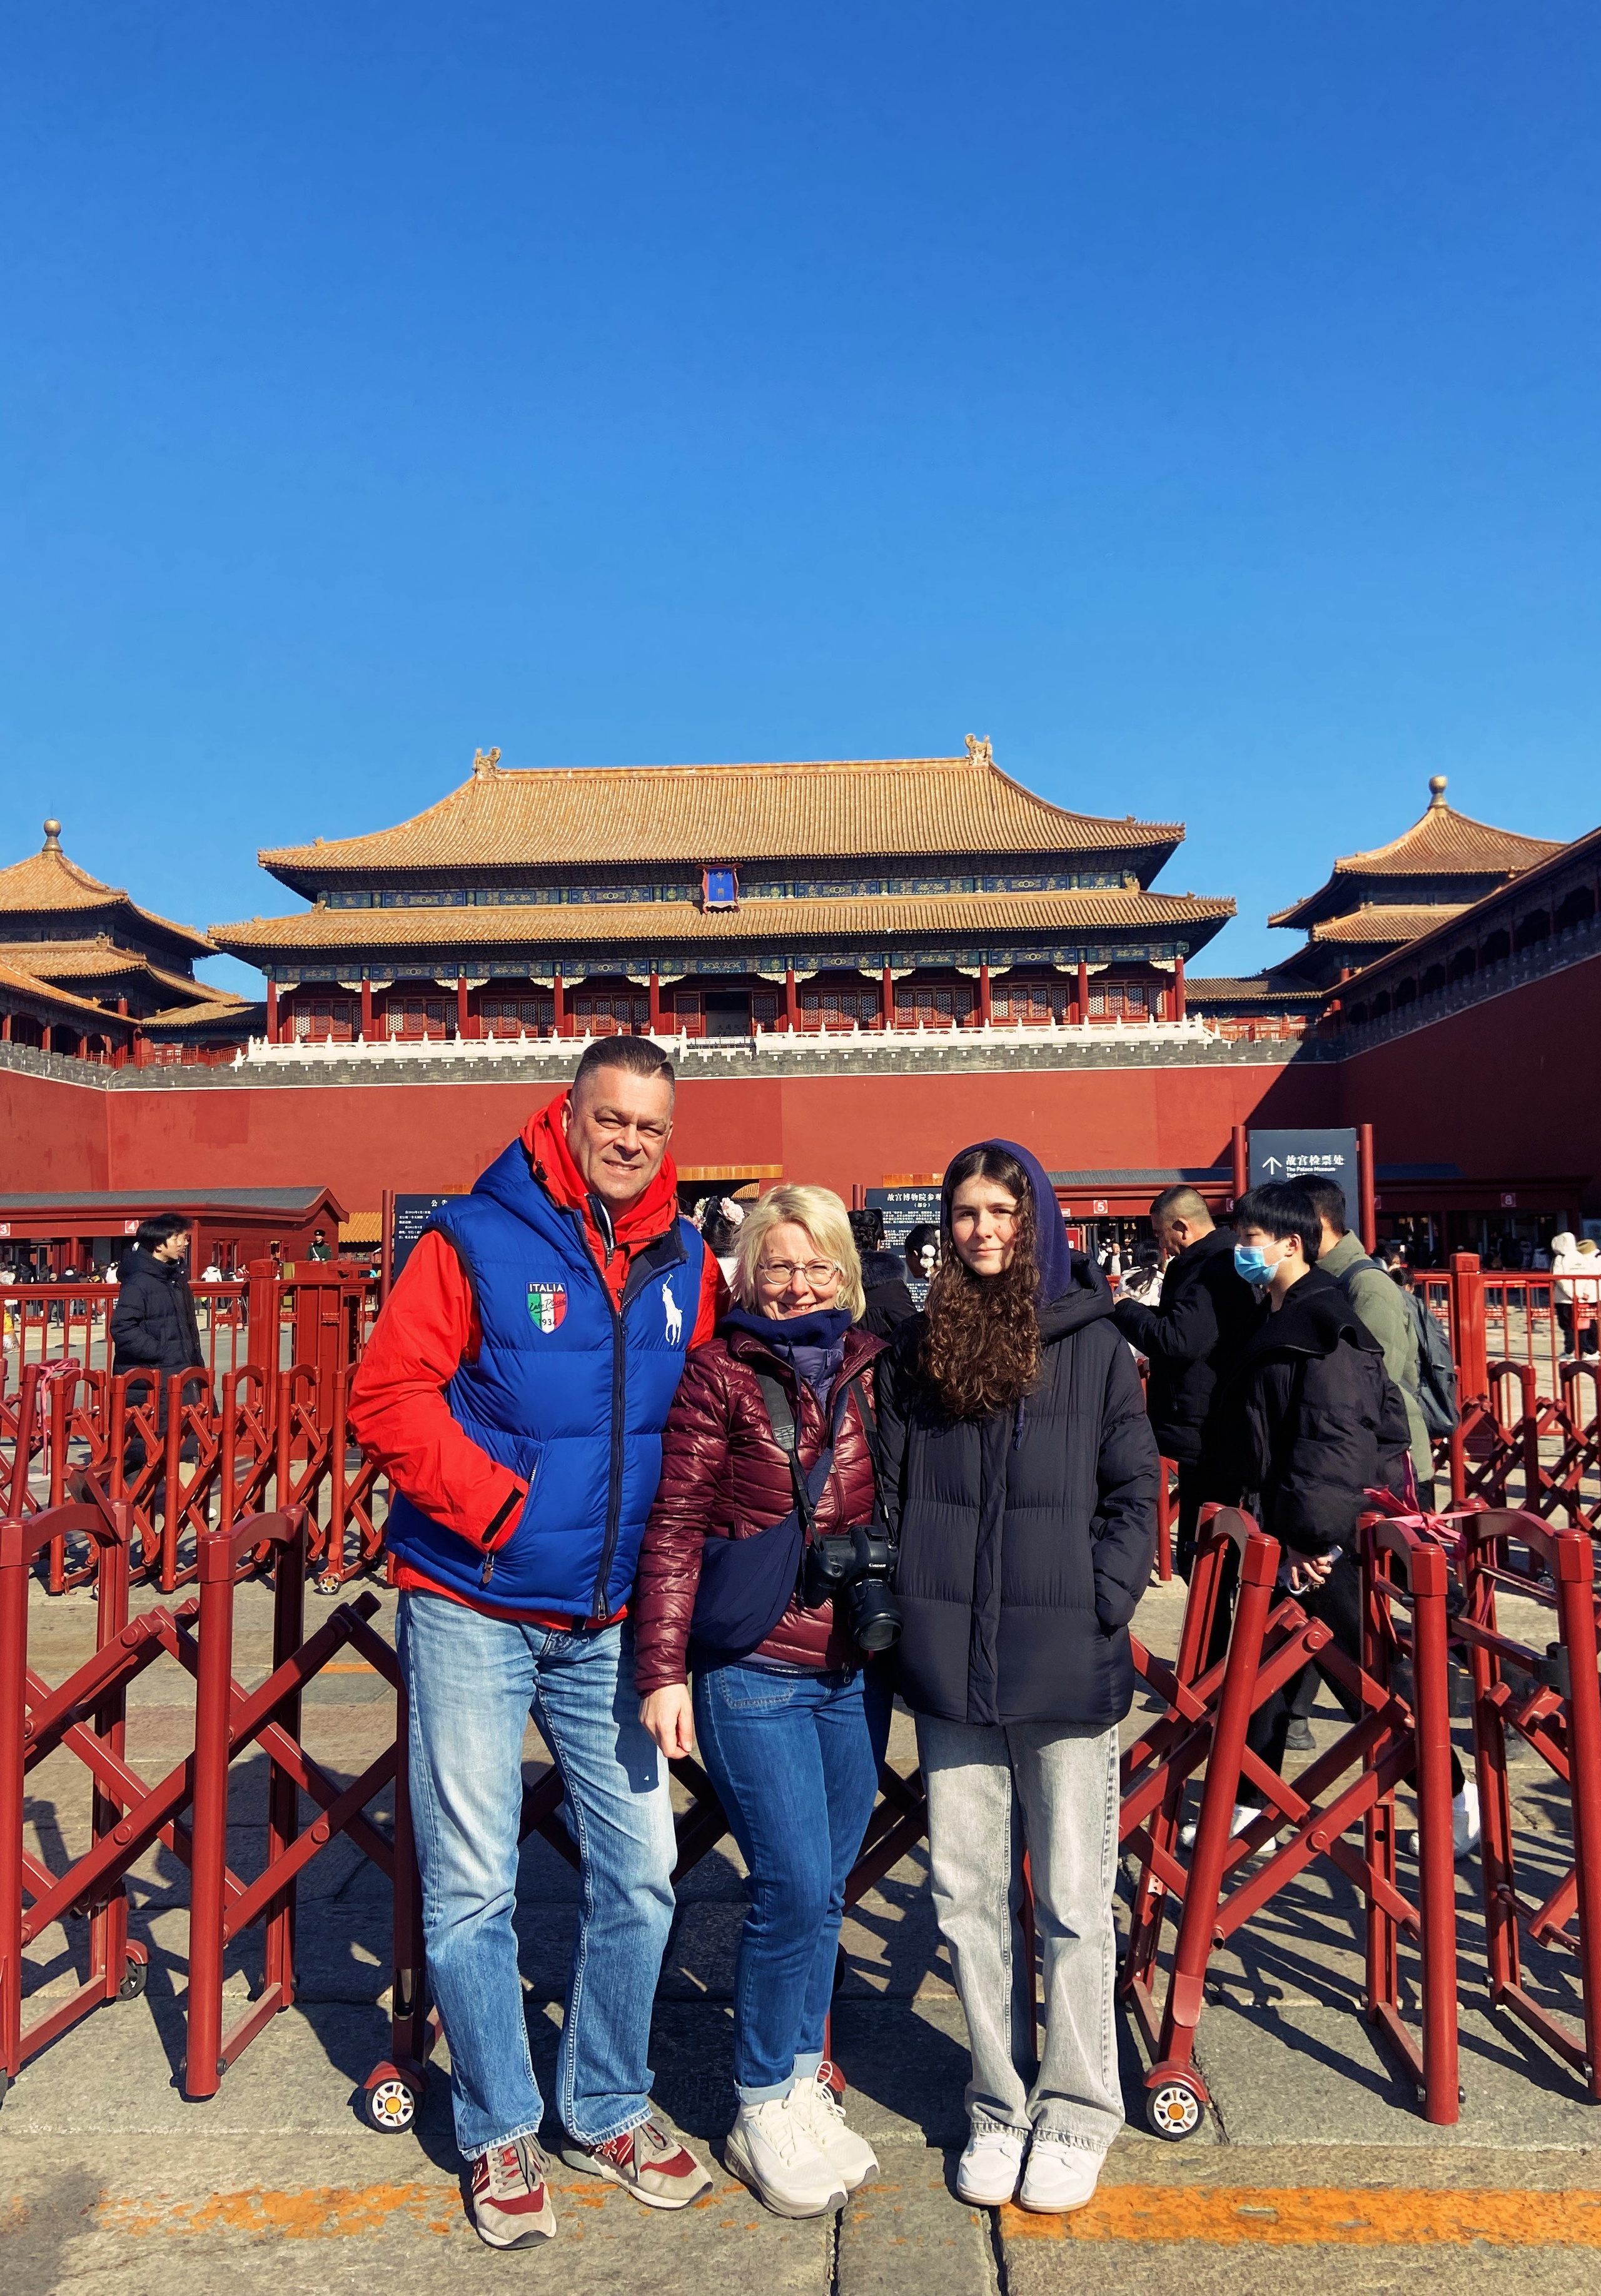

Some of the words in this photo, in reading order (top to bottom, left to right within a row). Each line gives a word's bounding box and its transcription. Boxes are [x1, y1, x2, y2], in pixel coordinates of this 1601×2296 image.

[1286, 1155, 1345, 1166] 故宫检票处
[1098, 1201, 1105, 1212] 5
[0, 1224, 8, 1235] 3
[128, 1221, 136, 1231] 4
[529, 1283, 564, 1292] ITALIA
[538, 1318, 558, 1327] 1934
